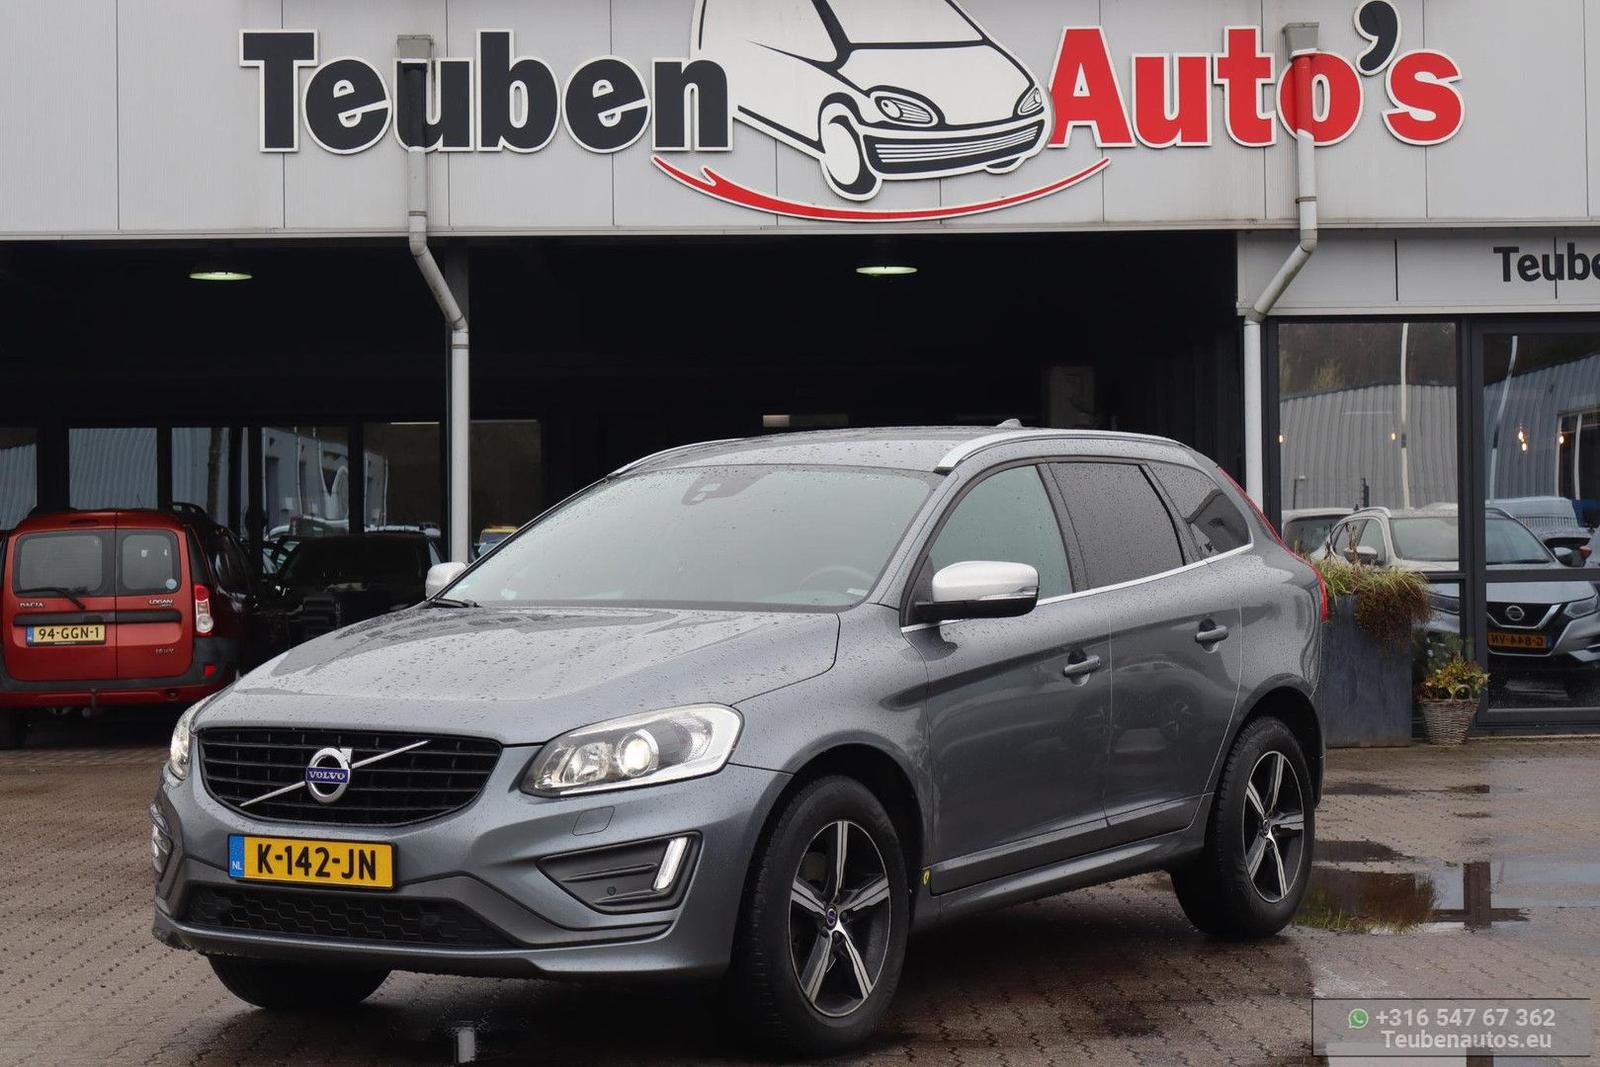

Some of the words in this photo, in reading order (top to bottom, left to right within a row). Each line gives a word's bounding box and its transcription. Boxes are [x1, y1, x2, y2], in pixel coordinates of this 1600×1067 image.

[239, 29, 733, 154] Teuben
[1048, 0, 1465, 148] Auto's
[38, 627, 99, 640] 94-GGN-1
[309, 770, 346, 780] VOLVO
[232, 860, 243, 870] NL
[257, 843, 376, 881] K-142-JN
